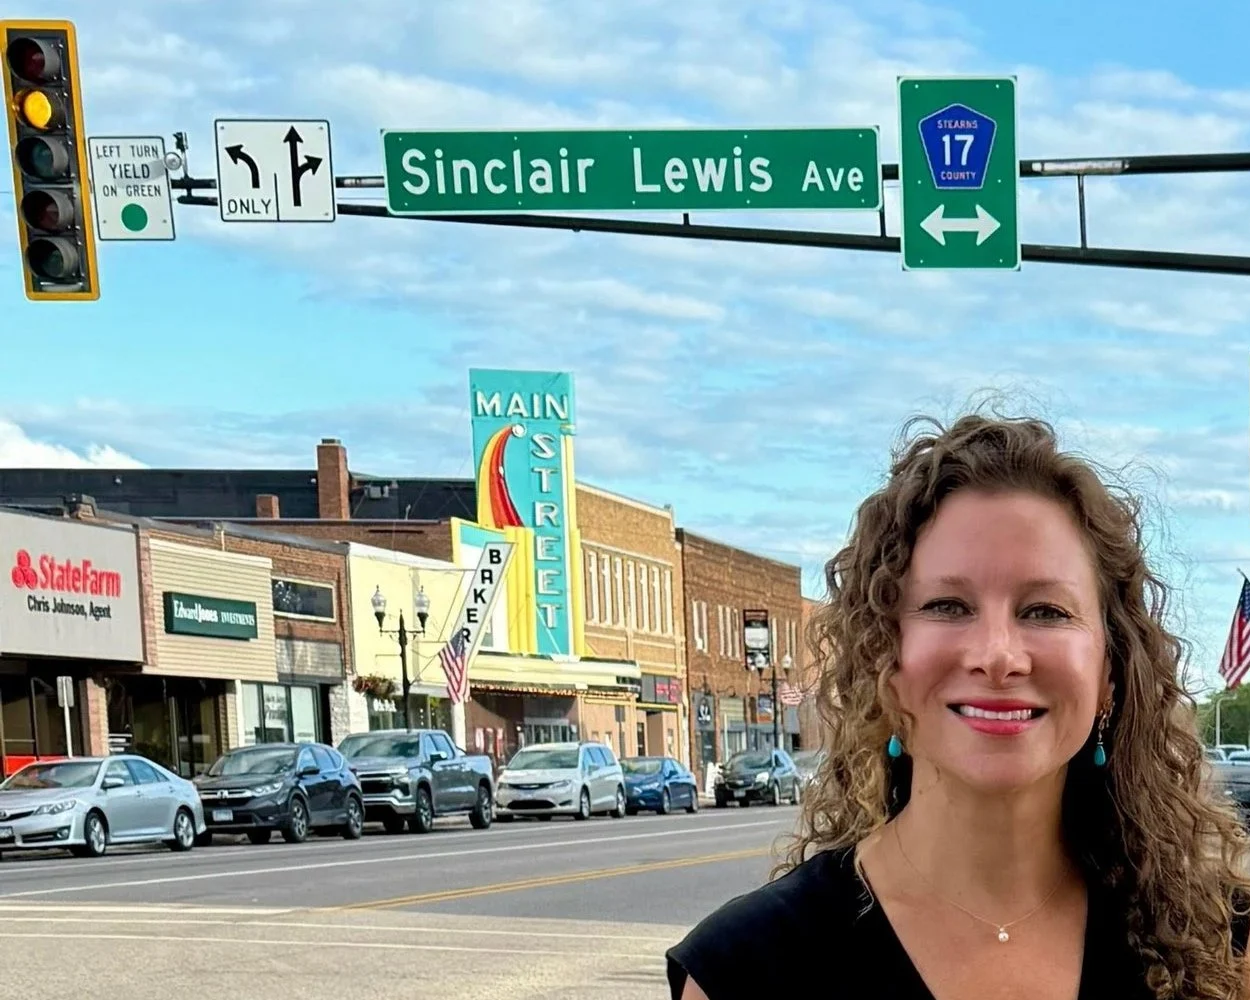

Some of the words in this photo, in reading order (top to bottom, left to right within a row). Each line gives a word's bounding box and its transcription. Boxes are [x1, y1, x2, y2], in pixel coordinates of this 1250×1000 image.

[937, 119, 978, 129] STEARNS
[96, 145, 123, 158] LEFT
[130, 145, 159, 158] TURN
[942, 134, 974, 166] 17
[109, 164, 150, 180] YIELD
[402, 147, 595, 195] Sinclair
[633, 146, 773, 193] Lewis
[801, 160, 864, 192] Ave
[940, 171, 976, 181] COUNTY
[103, 184, 119, 197] ON
[126, 184, 161, 197] GREEN
[227, 199, 271, 214] ONLY
[475, 390, 569, 420] MAIN
[531, 432, 561, 630] STREET
[27, 595, 50, 613] Chris
[52, 597, 88, 620] Johnson,
[89, 601, 112, 621] Agent
